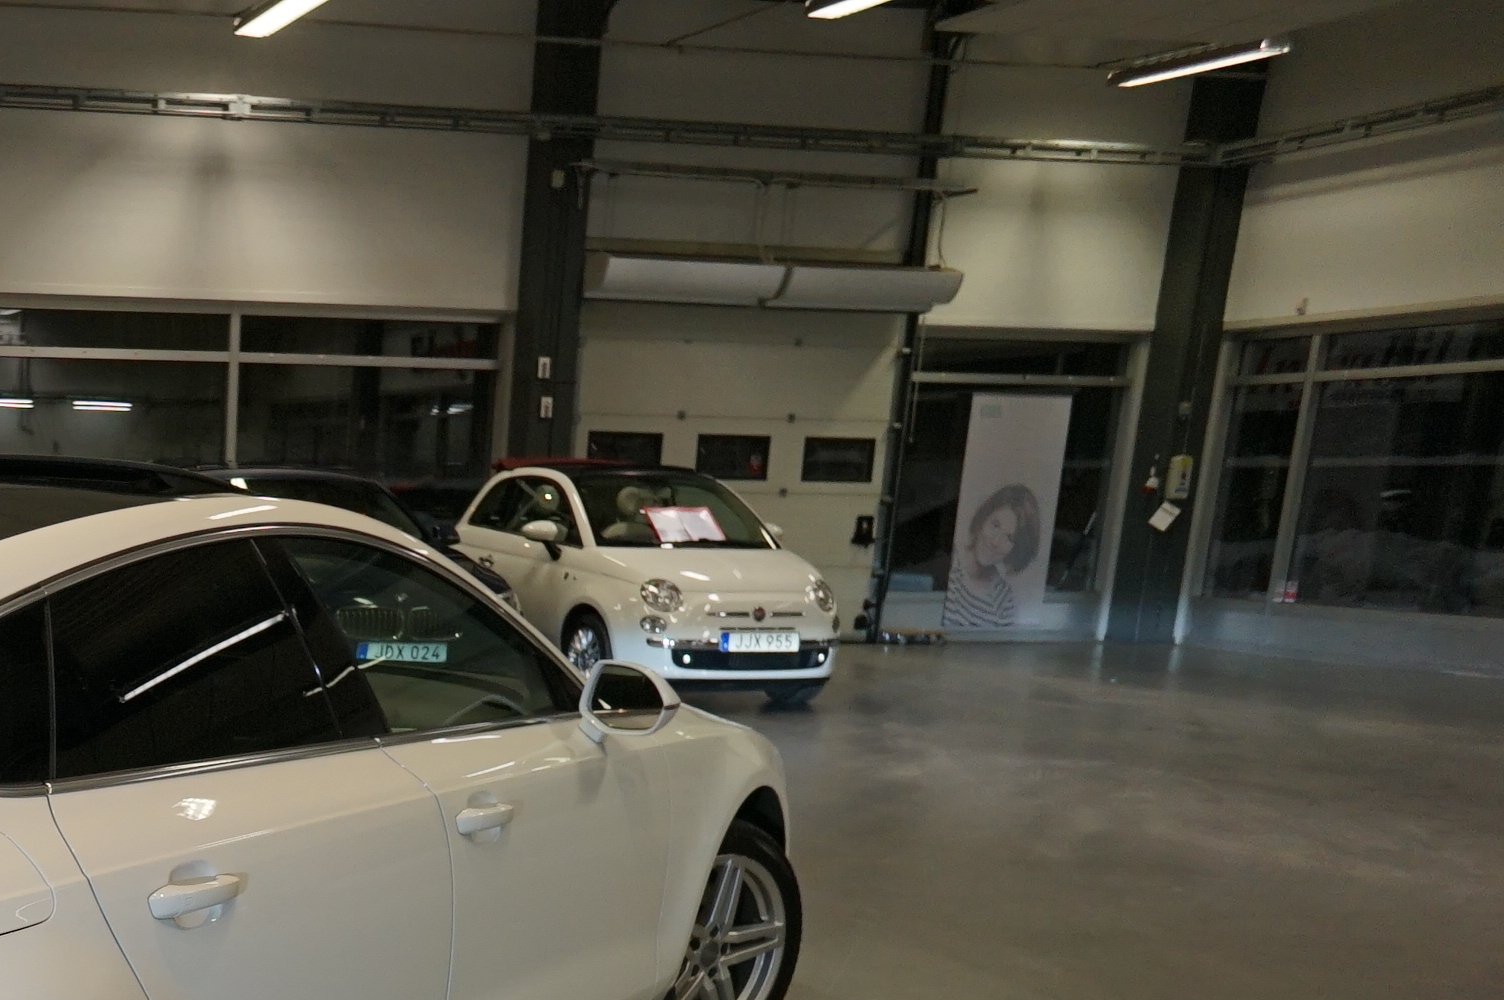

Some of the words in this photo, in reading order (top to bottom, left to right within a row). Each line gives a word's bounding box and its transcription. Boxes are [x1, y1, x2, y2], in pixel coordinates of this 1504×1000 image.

[736, 633, 761, 649] JJX
[766, 633, 792, 649] 955
[374, 644, 405, 660] JDX
[410, 645, 440, 660] 024
